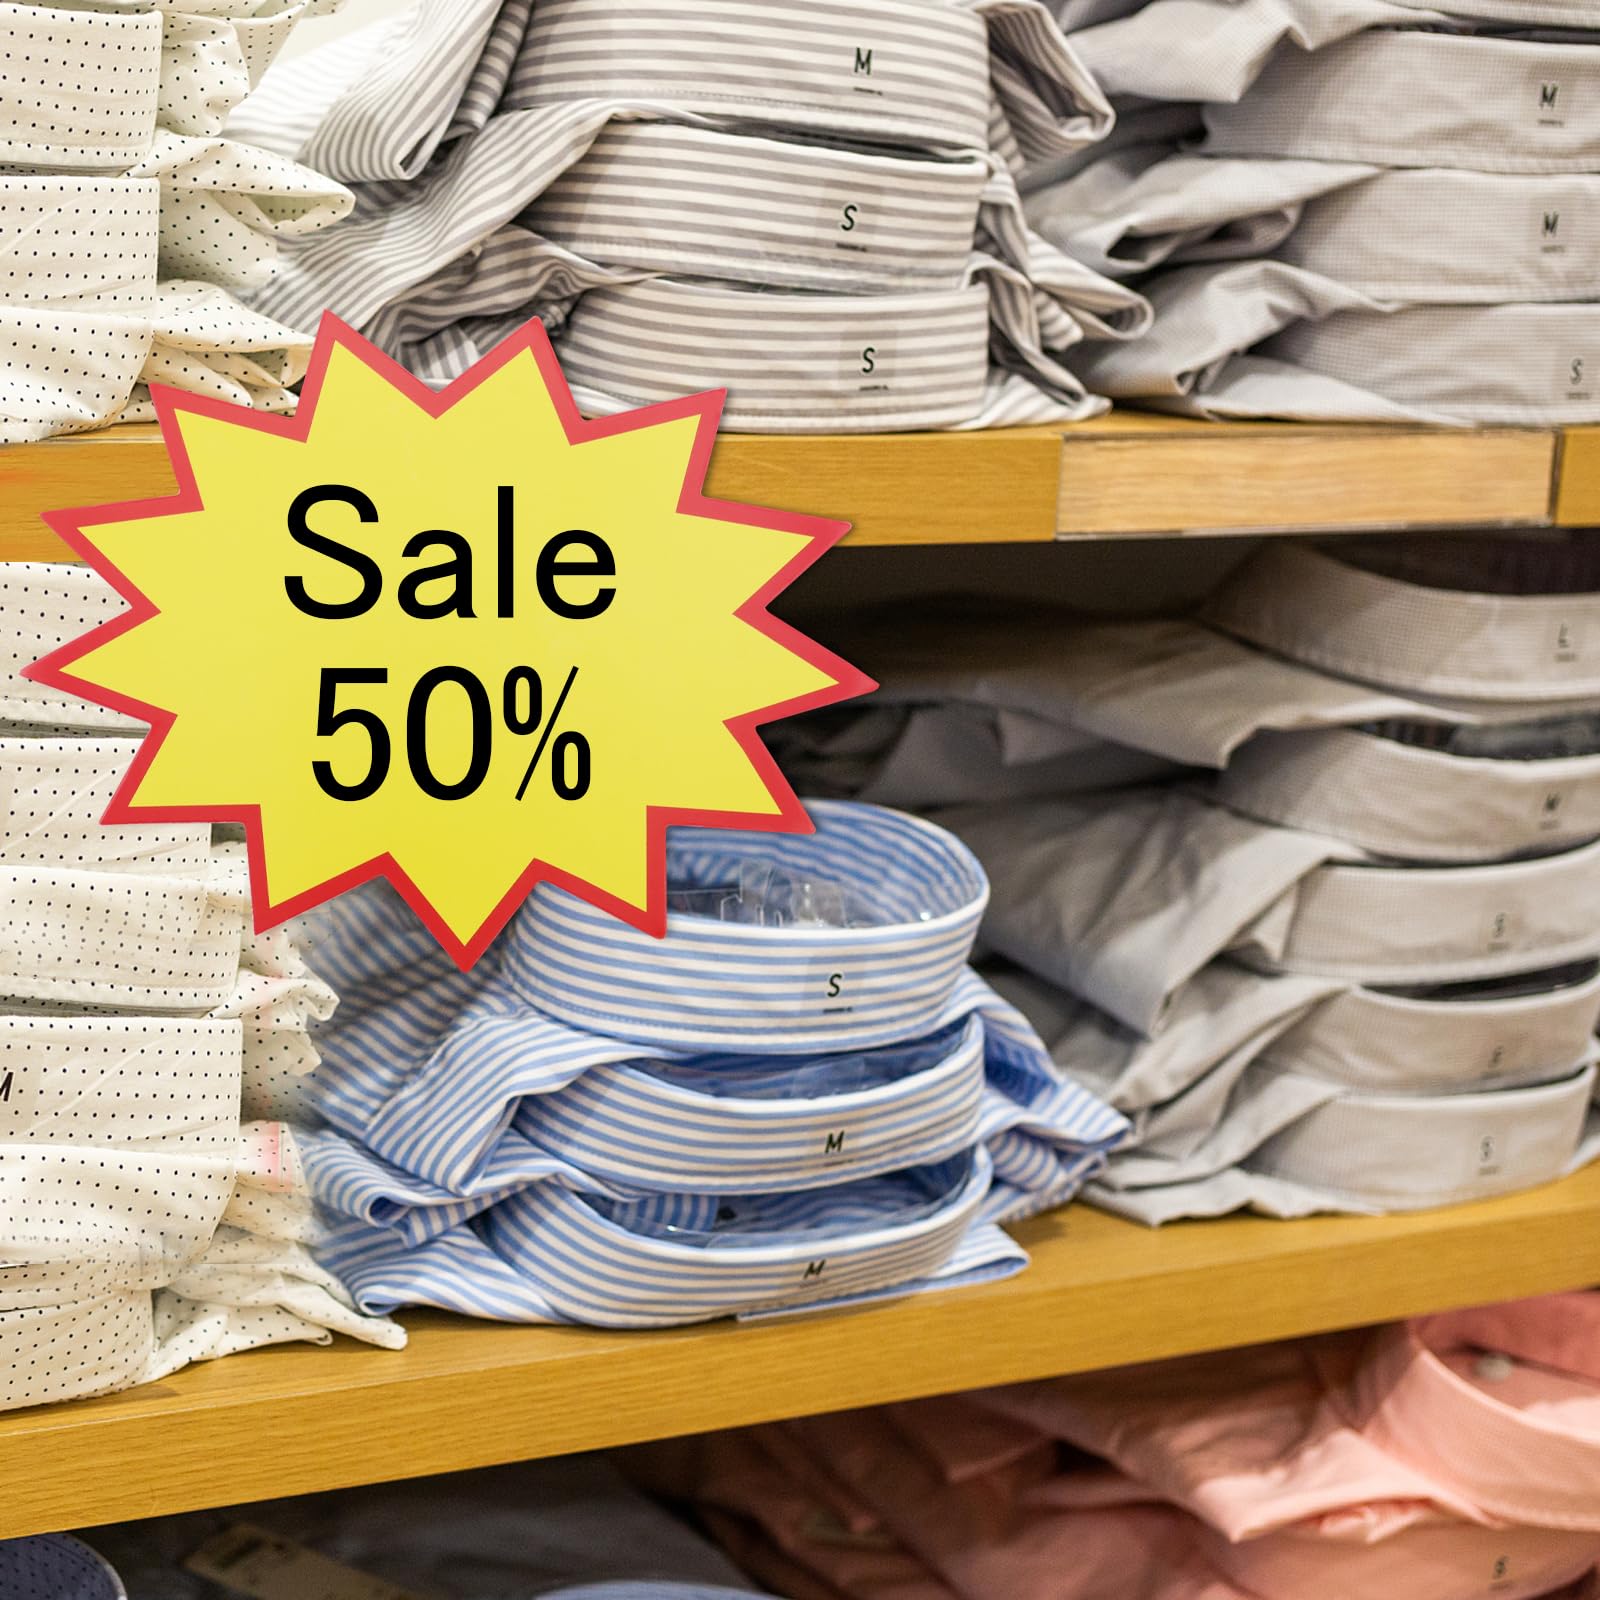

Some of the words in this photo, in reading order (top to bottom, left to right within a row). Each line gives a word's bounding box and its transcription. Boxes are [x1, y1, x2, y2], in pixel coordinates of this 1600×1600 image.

[853, 46, 872, 76] M
[1539, 83, 1559, 110] M
[840, 204, 858, 232] S
[1541, 211, 1560, 239] M
[860, 346, 876, 374] S
[1568, 357, 1583, 385] S
[826, 972, 842, 998] S
[824, 1129, 845, 1154] M
[803, 1258, 826, 1280] M
